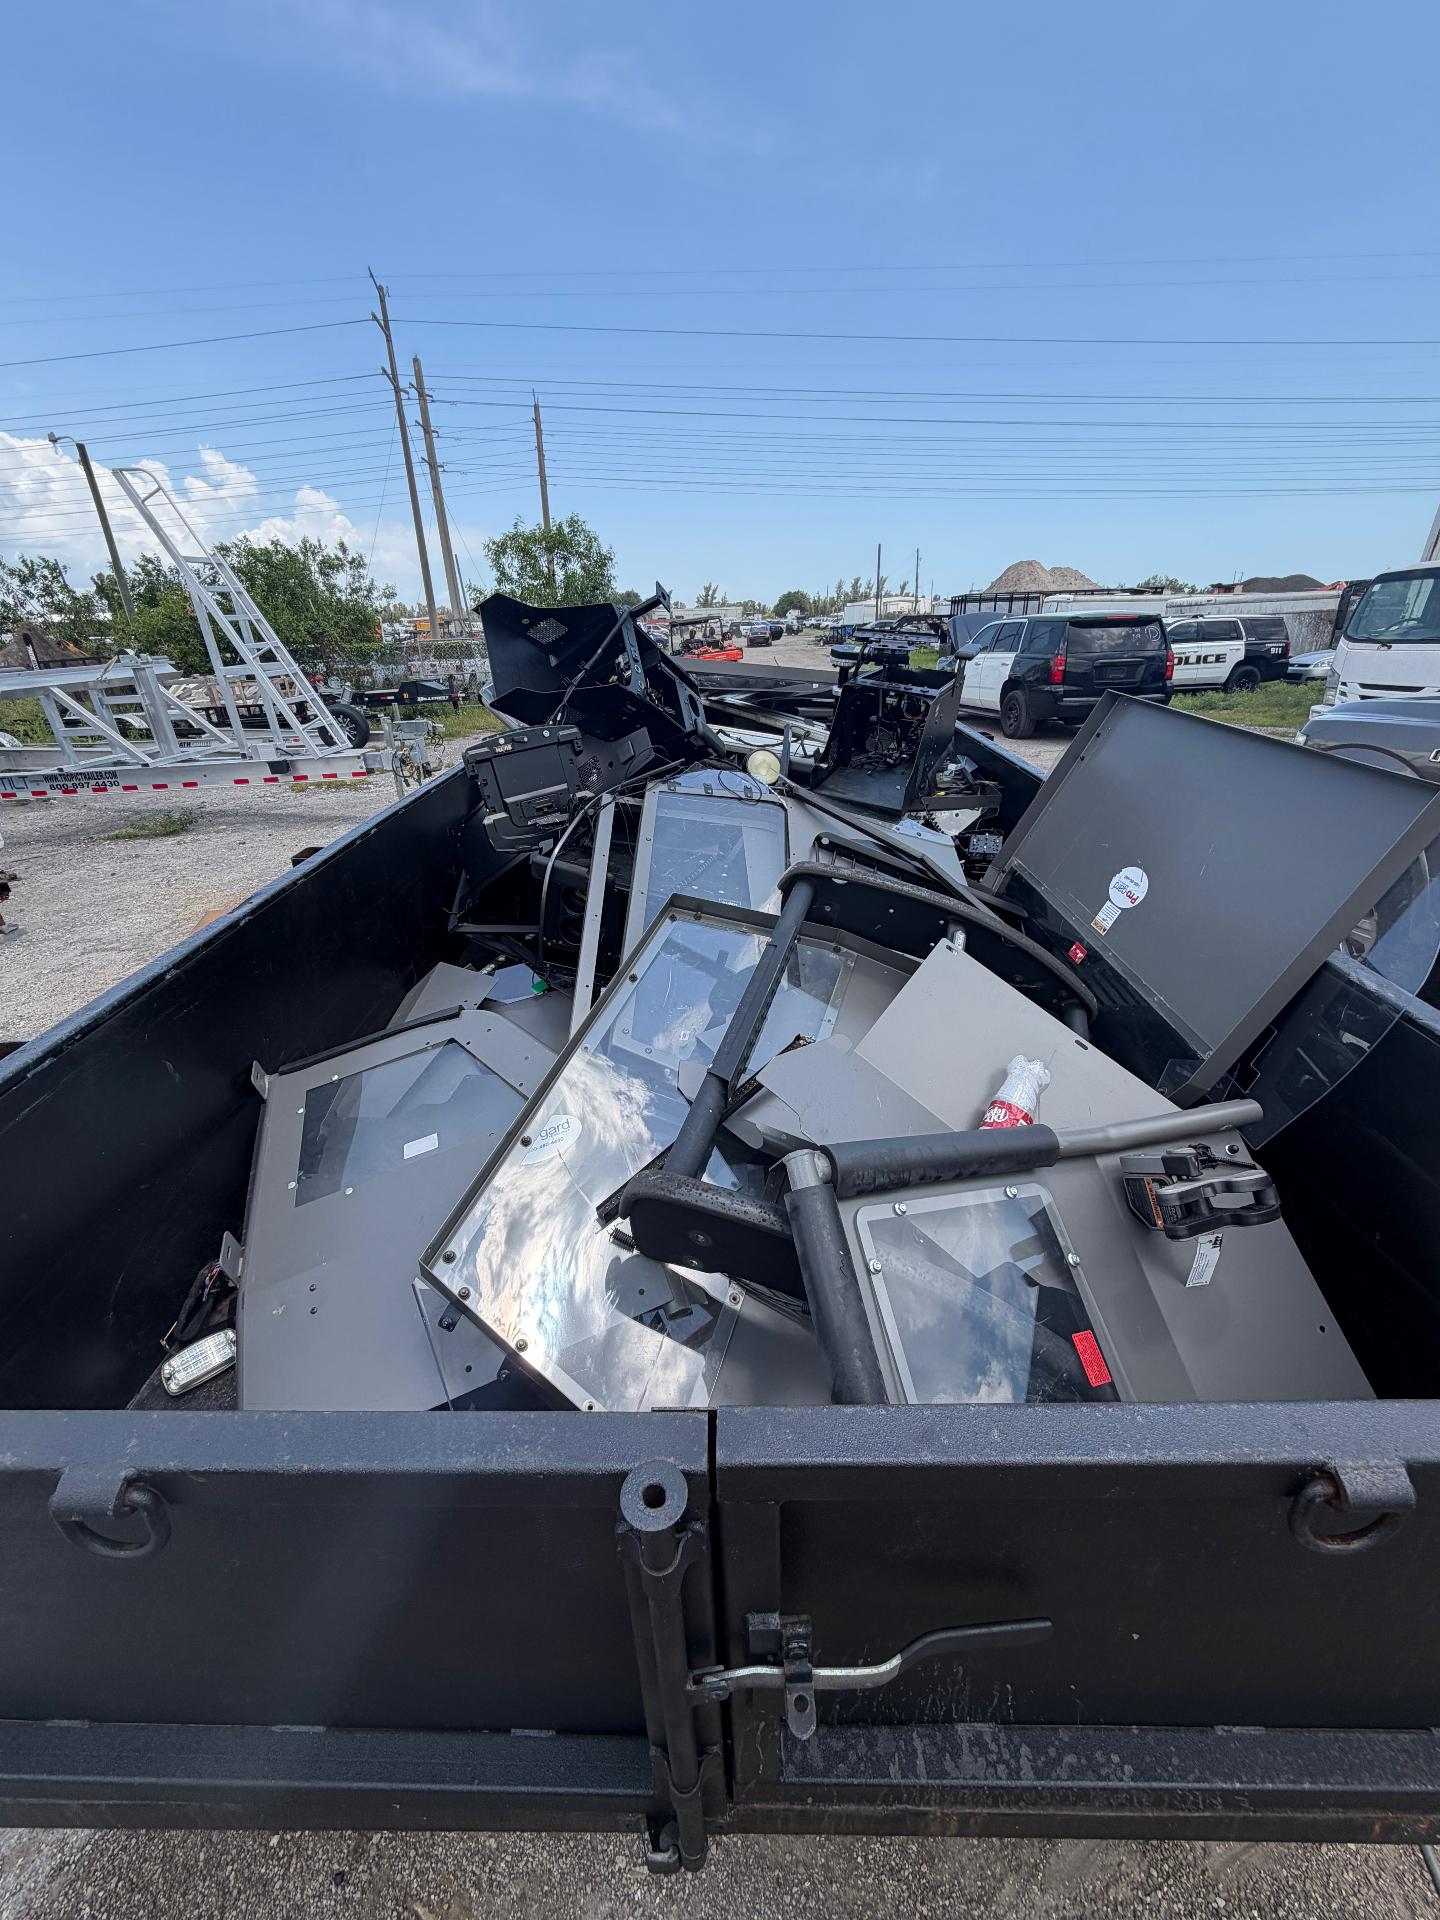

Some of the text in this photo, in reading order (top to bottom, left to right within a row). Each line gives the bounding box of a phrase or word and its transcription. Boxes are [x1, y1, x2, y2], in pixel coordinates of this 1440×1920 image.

[1174, 653, 1227, 665] OLICE
[0, 775, 29, 790] TILT
[42, 771, 119, 783] WWW.TROPICTRAILER.COM
[48, 780, 121, 790] 800-897-4430
